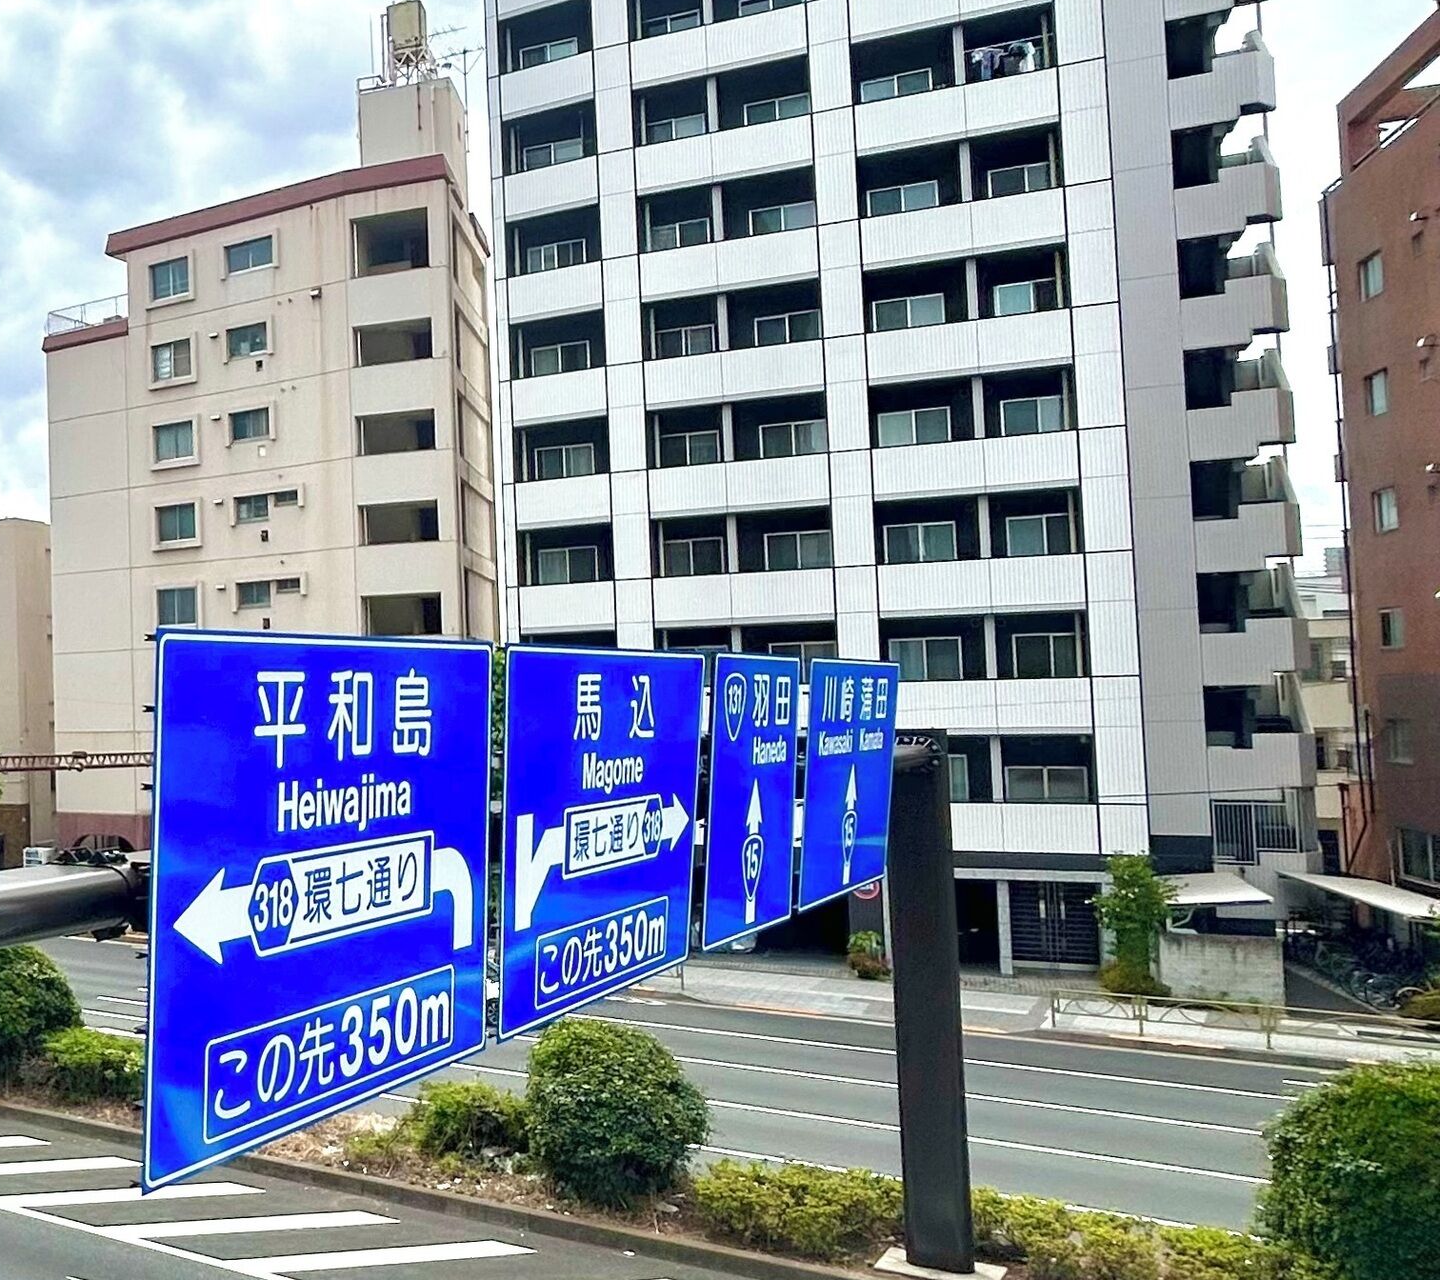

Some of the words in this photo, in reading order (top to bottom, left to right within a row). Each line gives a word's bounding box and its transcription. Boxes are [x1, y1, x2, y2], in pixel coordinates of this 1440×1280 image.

[254, 667, 433, 768] 平和島
[574, 673, 655, 741] 馬込
[728, 682, 742, 715] 131
[752, 674, 791, 727] 羽田
[752, 735, 787, 766] Haneda
[818, 728, 854, 757] Kawasaki
[582, 751, 644, 794] Magome
[276, 773, 412, 832] Heiwajima
[644, 810, 660, 842] 318
[572, 811, 641, 862] 環七通り
[844, 818, 854, 847] 15
[746, 842, 759, 880] 15
[254, 878, 295, 932] 318
[303, 851, 419, 924] 環七通り
[539, 909, 665, 995] この先350m
[213, 985, 450, 1120] この先350m
